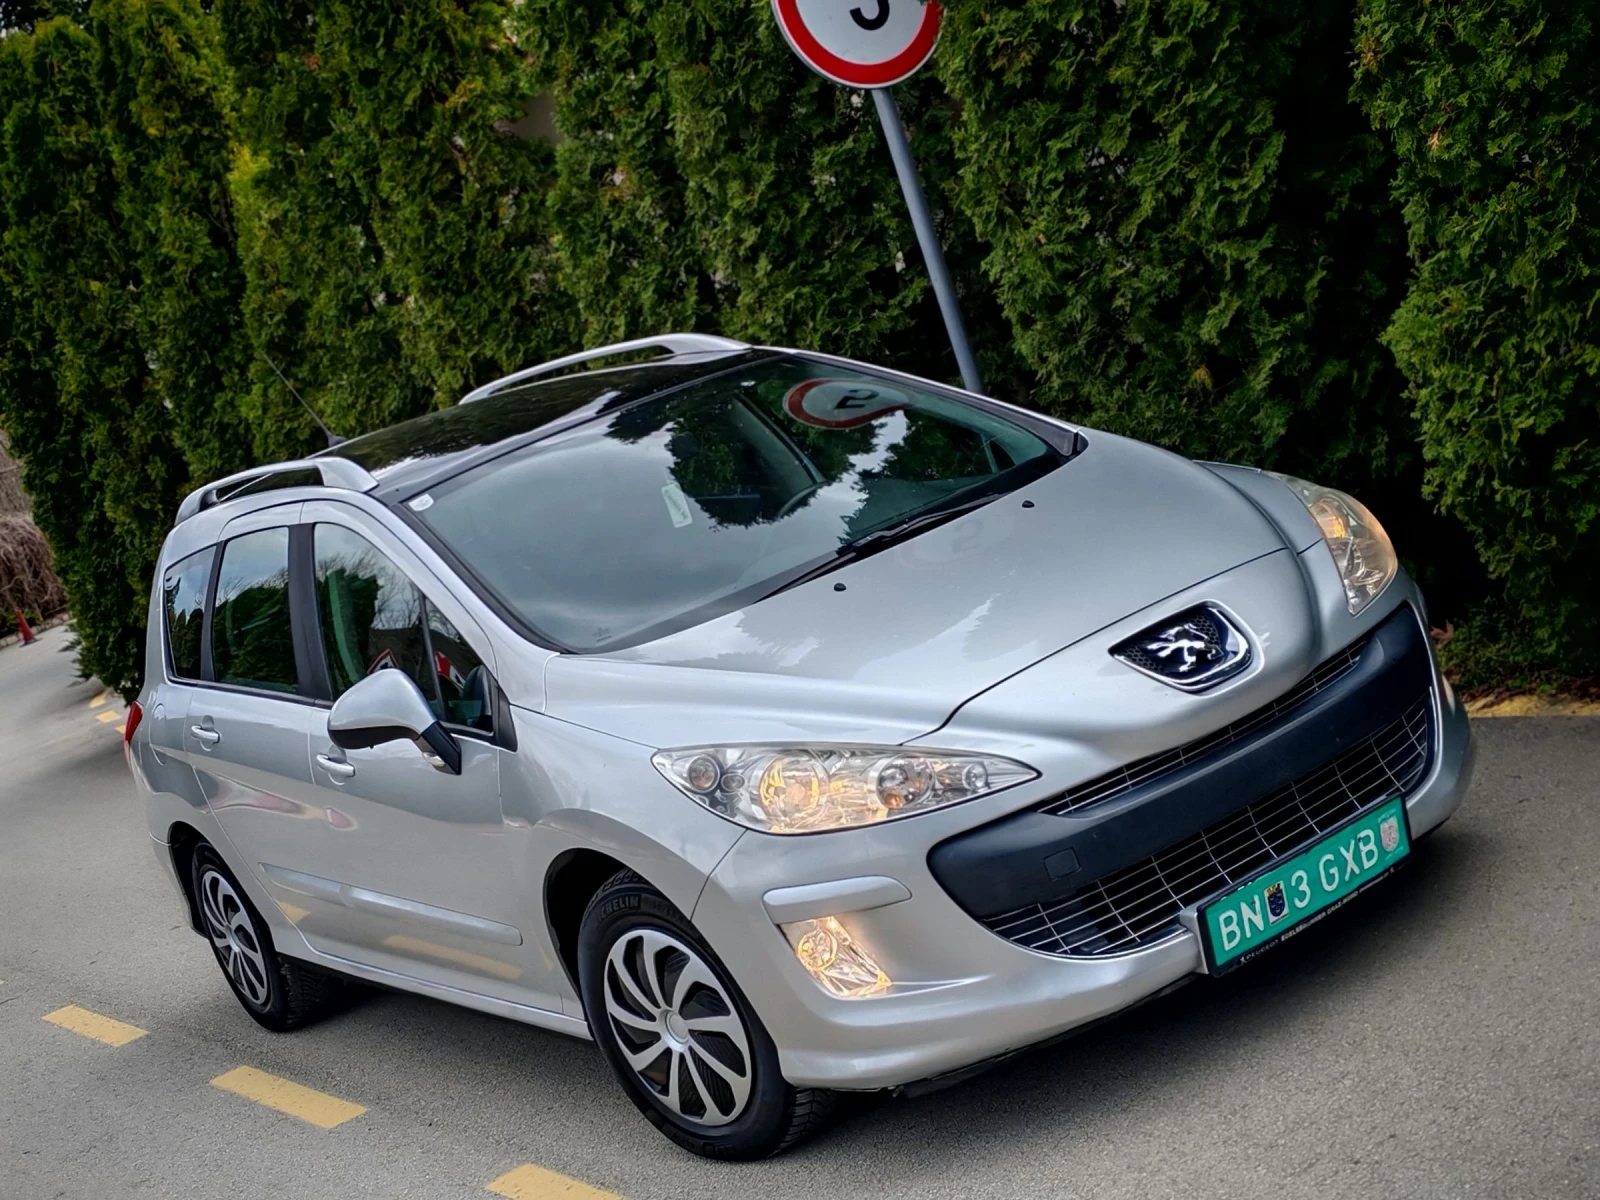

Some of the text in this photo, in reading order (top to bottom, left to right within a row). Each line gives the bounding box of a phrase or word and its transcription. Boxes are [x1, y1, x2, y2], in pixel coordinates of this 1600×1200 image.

[1218, 828, 1379, 952] BN 3 GXB
